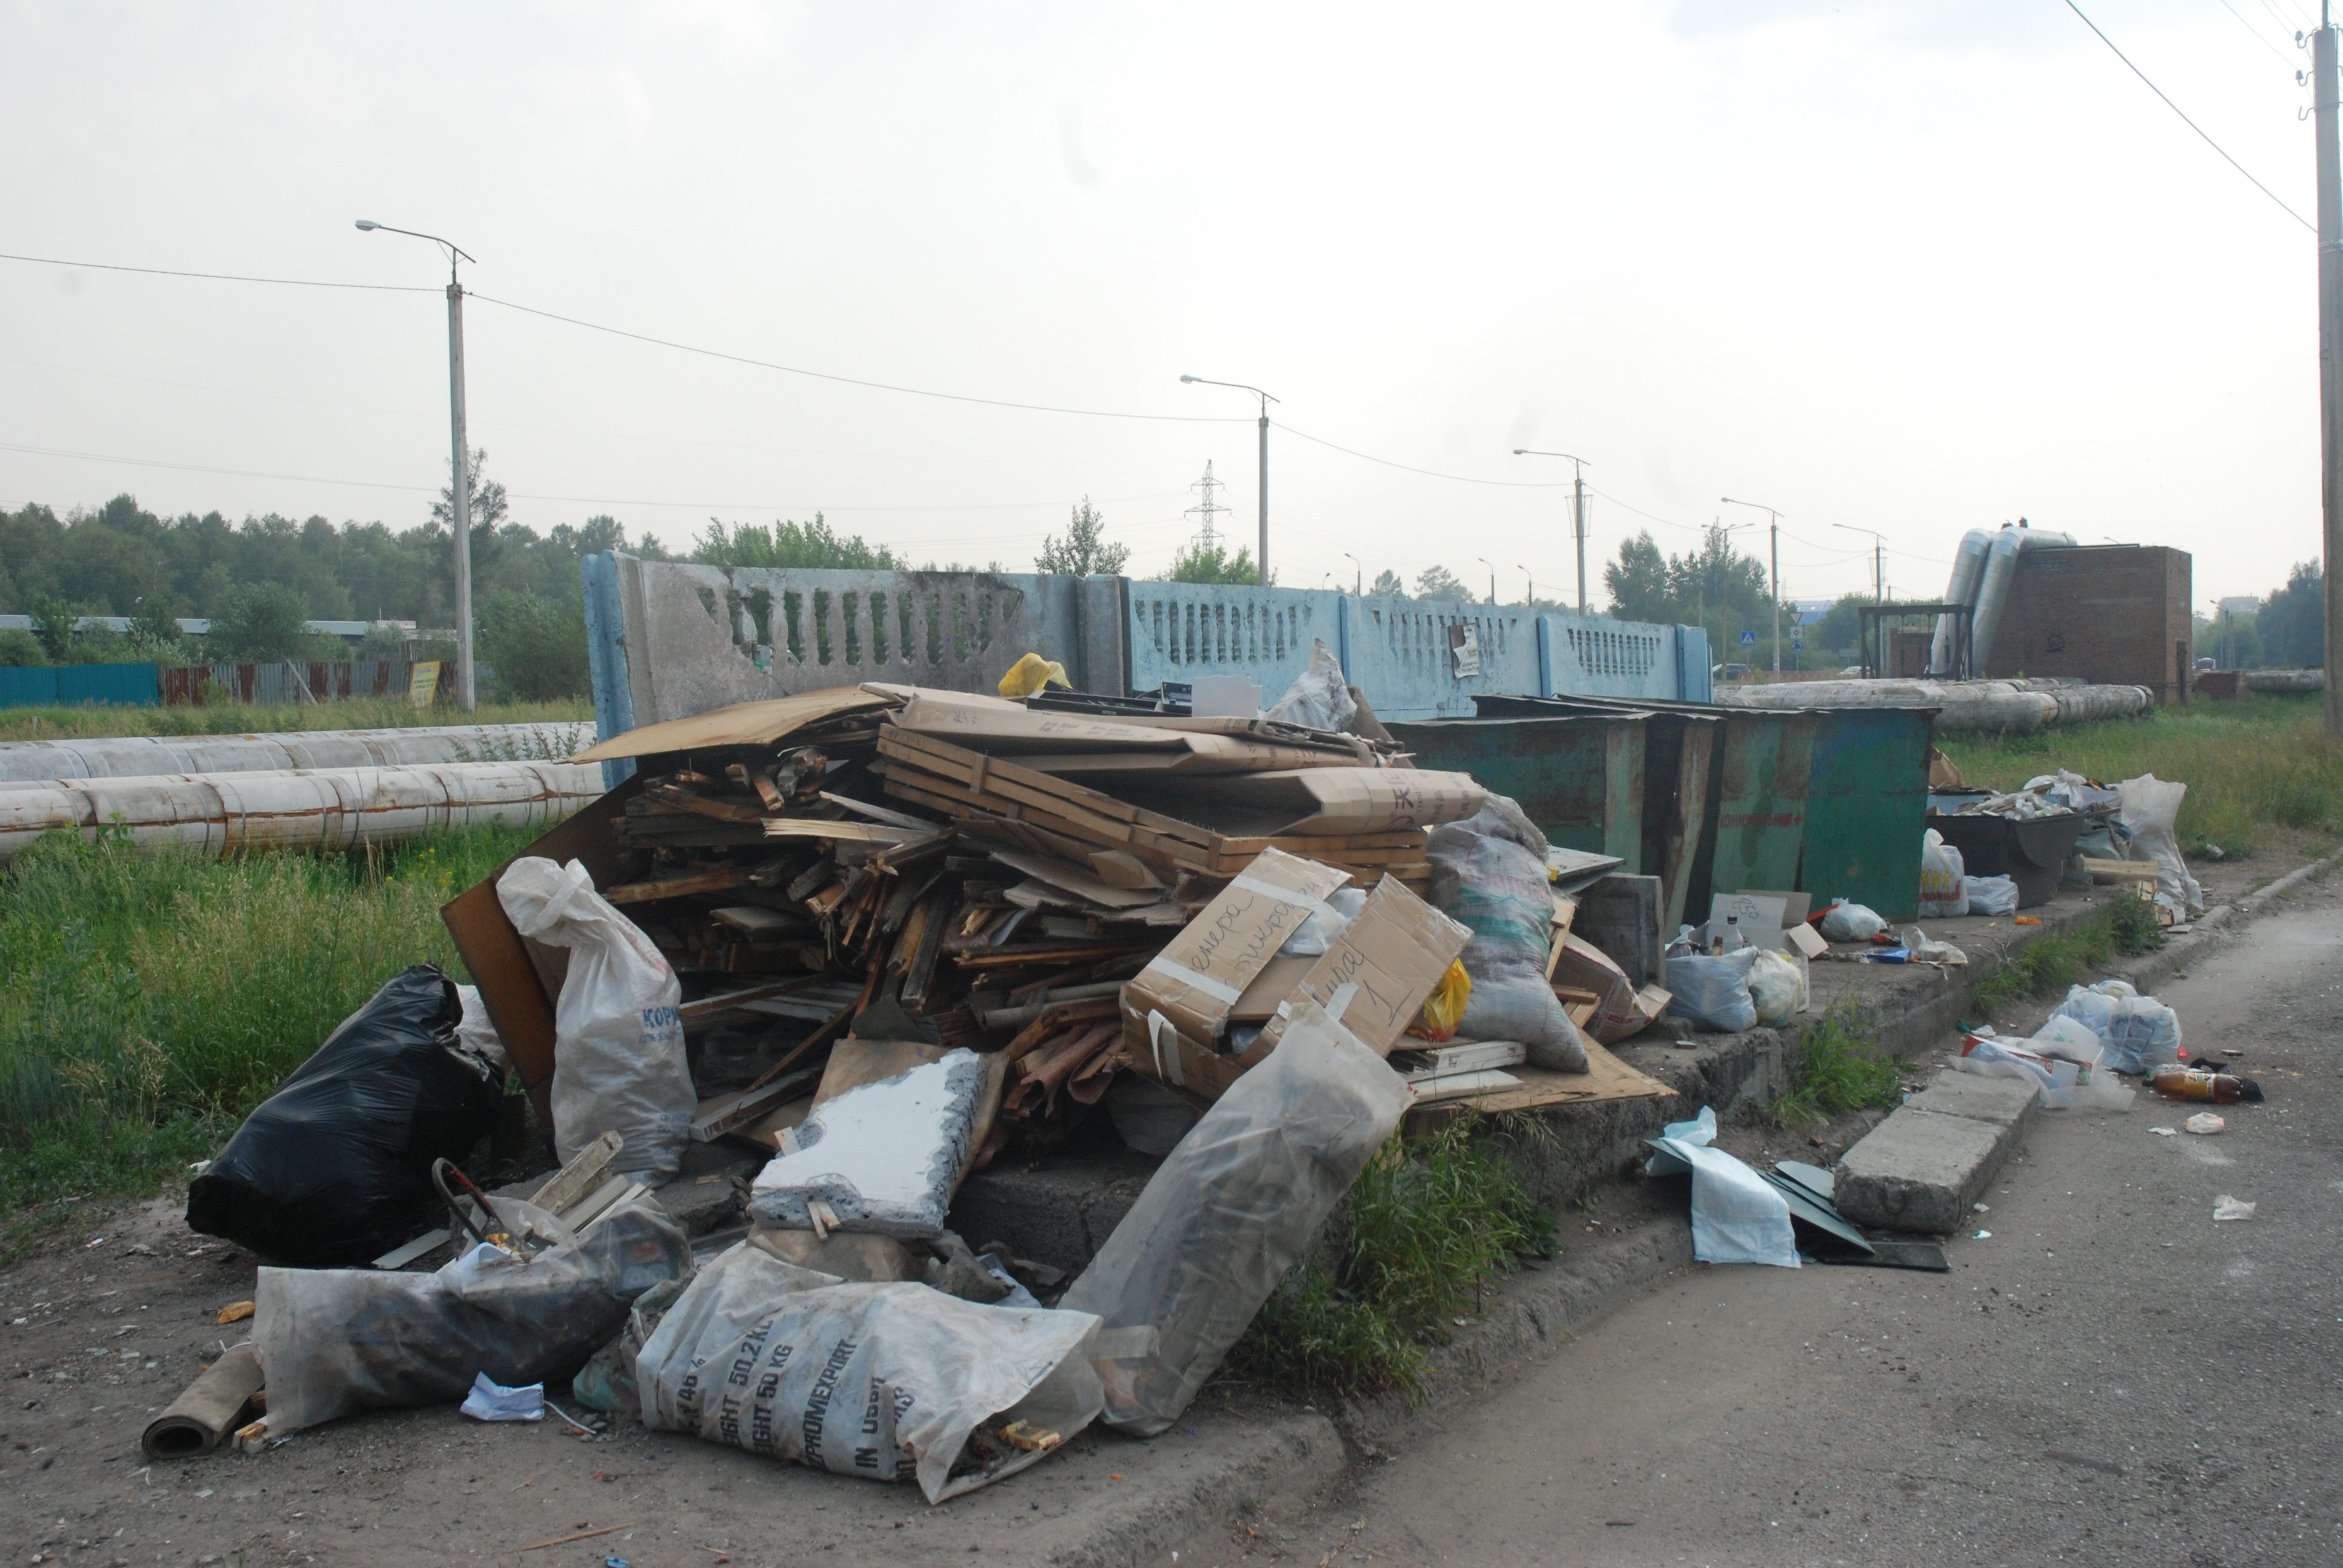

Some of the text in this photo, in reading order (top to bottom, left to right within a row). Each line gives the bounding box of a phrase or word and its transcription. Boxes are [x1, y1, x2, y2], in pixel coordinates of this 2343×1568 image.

[728, 1342, 762, 1387] 50,2
[757, 1372, 779, 1399] 50
[768, 1344, 794, 1368] KG
[854, 1447, 879, 1469] IN
